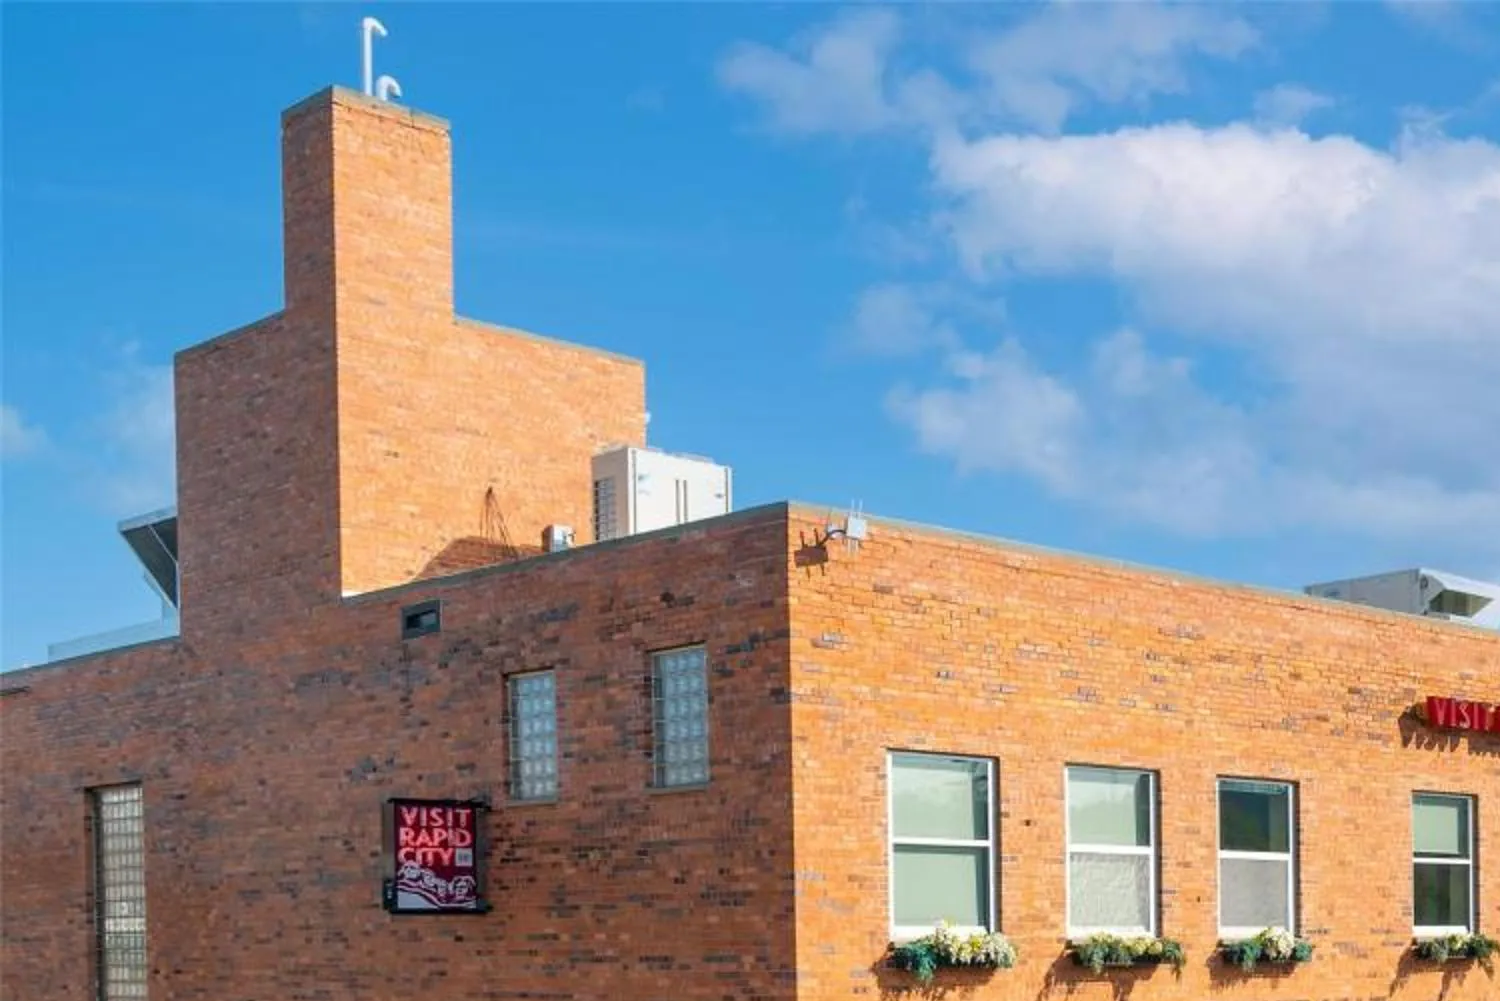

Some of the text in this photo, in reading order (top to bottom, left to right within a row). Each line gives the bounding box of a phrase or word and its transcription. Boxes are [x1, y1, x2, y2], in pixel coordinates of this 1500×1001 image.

[1433, 697, 1492, 732] VISIT
[401, 807, 472, 827] VISIT
[400, 827, 472, 847] RAPID
[398, 847, 455, 866] CITY
